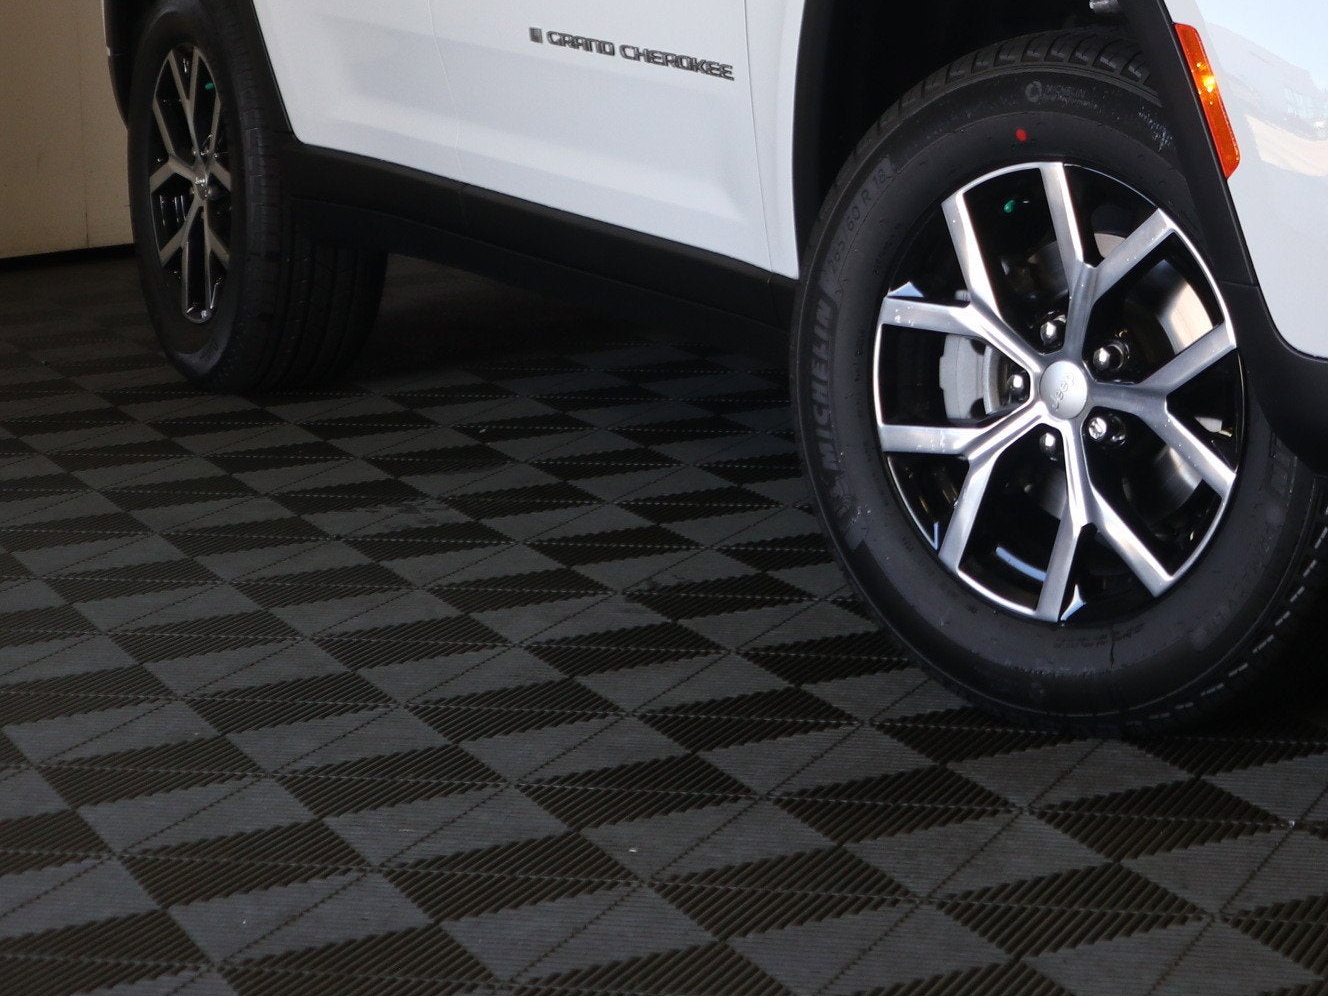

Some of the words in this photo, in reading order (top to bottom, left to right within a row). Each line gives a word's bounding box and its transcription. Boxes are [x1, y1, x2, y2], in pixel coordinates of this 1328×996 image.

[547, 30, 615, 56] GRAND
[619, 44, 735, 81] CHEROKEE
[811, 298, 842, 472] MICHELIN
